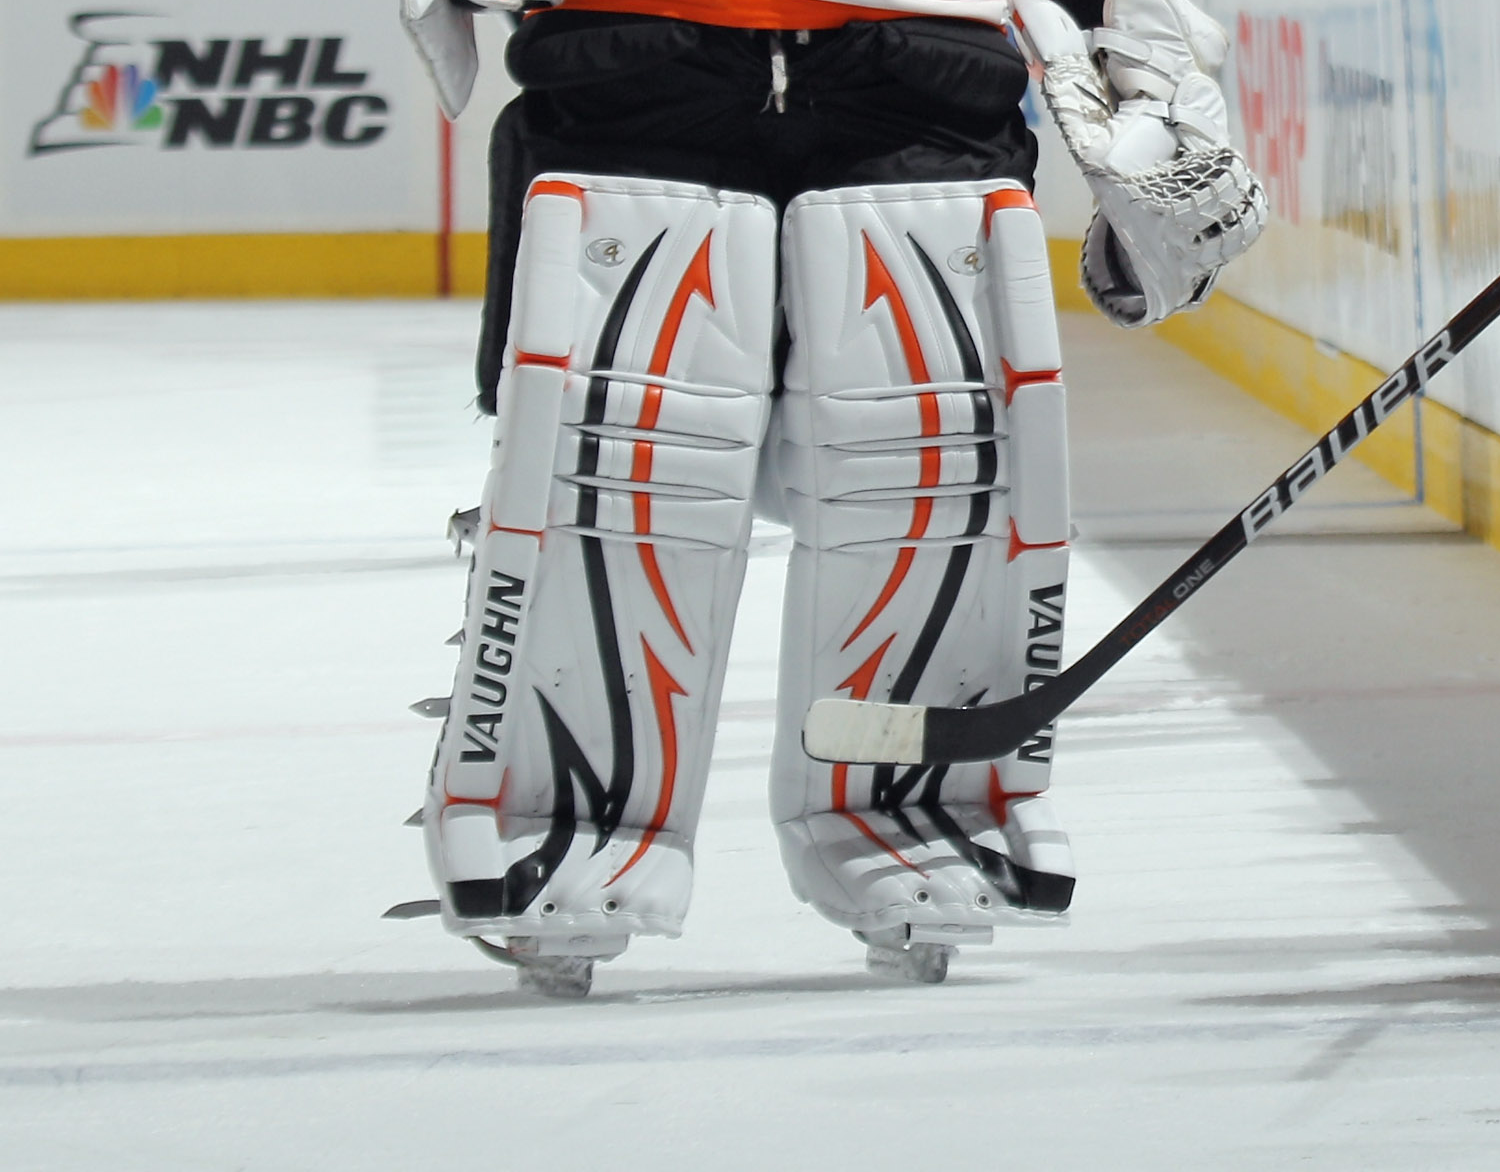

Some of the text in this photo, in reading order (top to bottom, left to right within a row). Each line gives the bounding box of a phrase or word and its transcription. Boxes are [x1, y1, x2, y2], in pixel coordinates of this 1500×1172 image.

[154, 37, 369, 88] NHL
[163, 95, 388, 149] NBC
[1241, 330, 1455, 545] BAUER
[1173, 558, 1216, 599] ONE
[458, 569, 527, 764] VAUGHN
